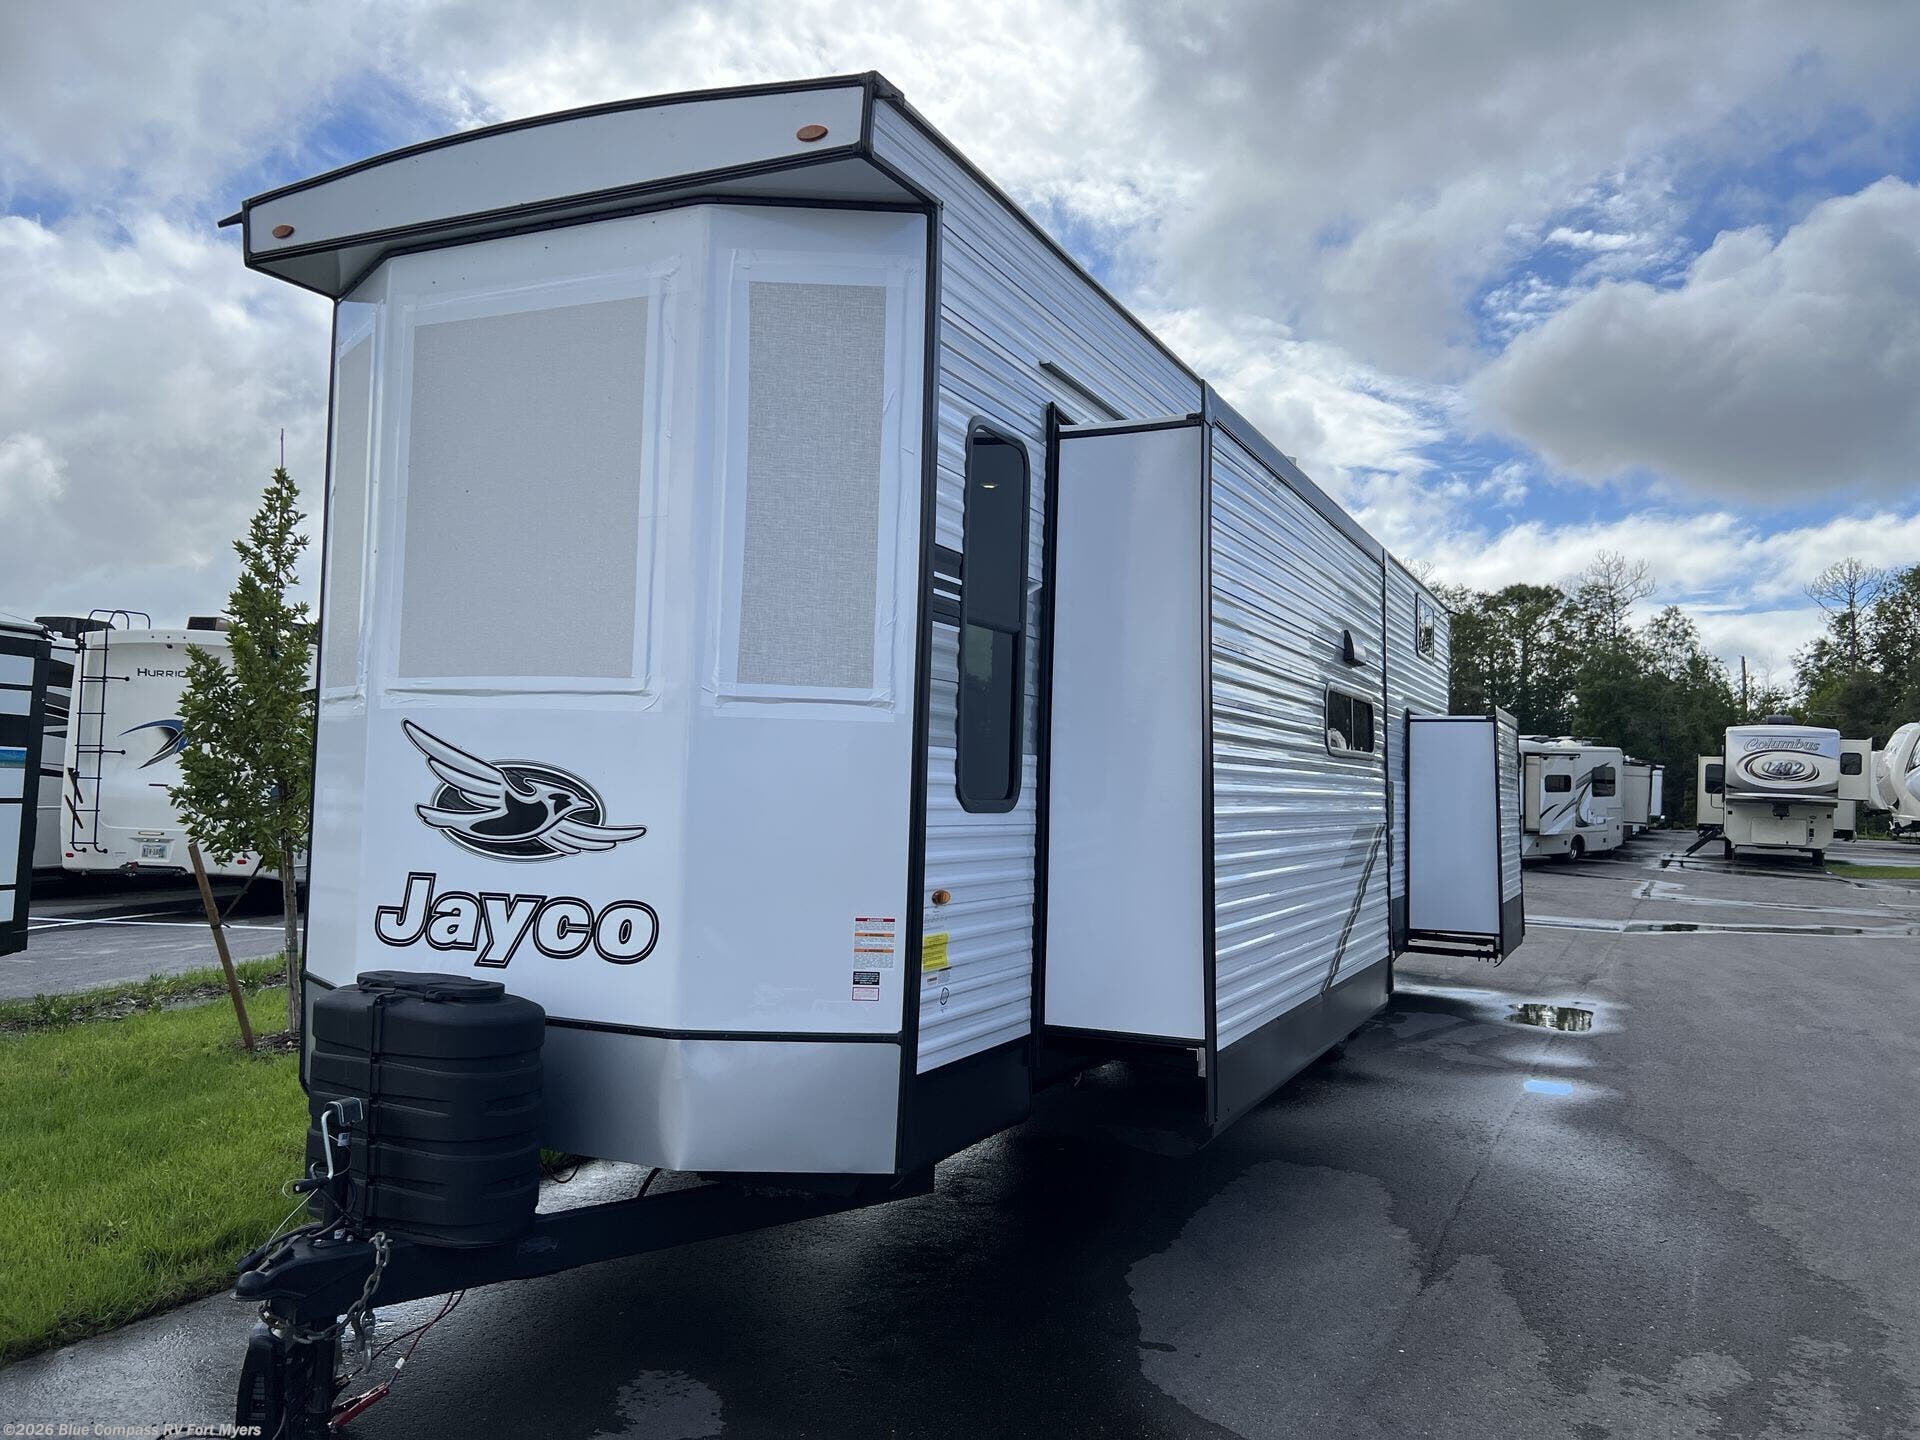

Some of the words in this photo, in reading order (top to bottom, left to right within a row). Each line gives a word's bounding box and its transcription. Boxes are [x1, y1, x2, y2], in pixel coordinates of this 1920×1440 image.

[137, 667, 187, 678] HURRIC
[1743, 738, 1820, 752] Columbus
[375, 871, 659, 968] Jayco
